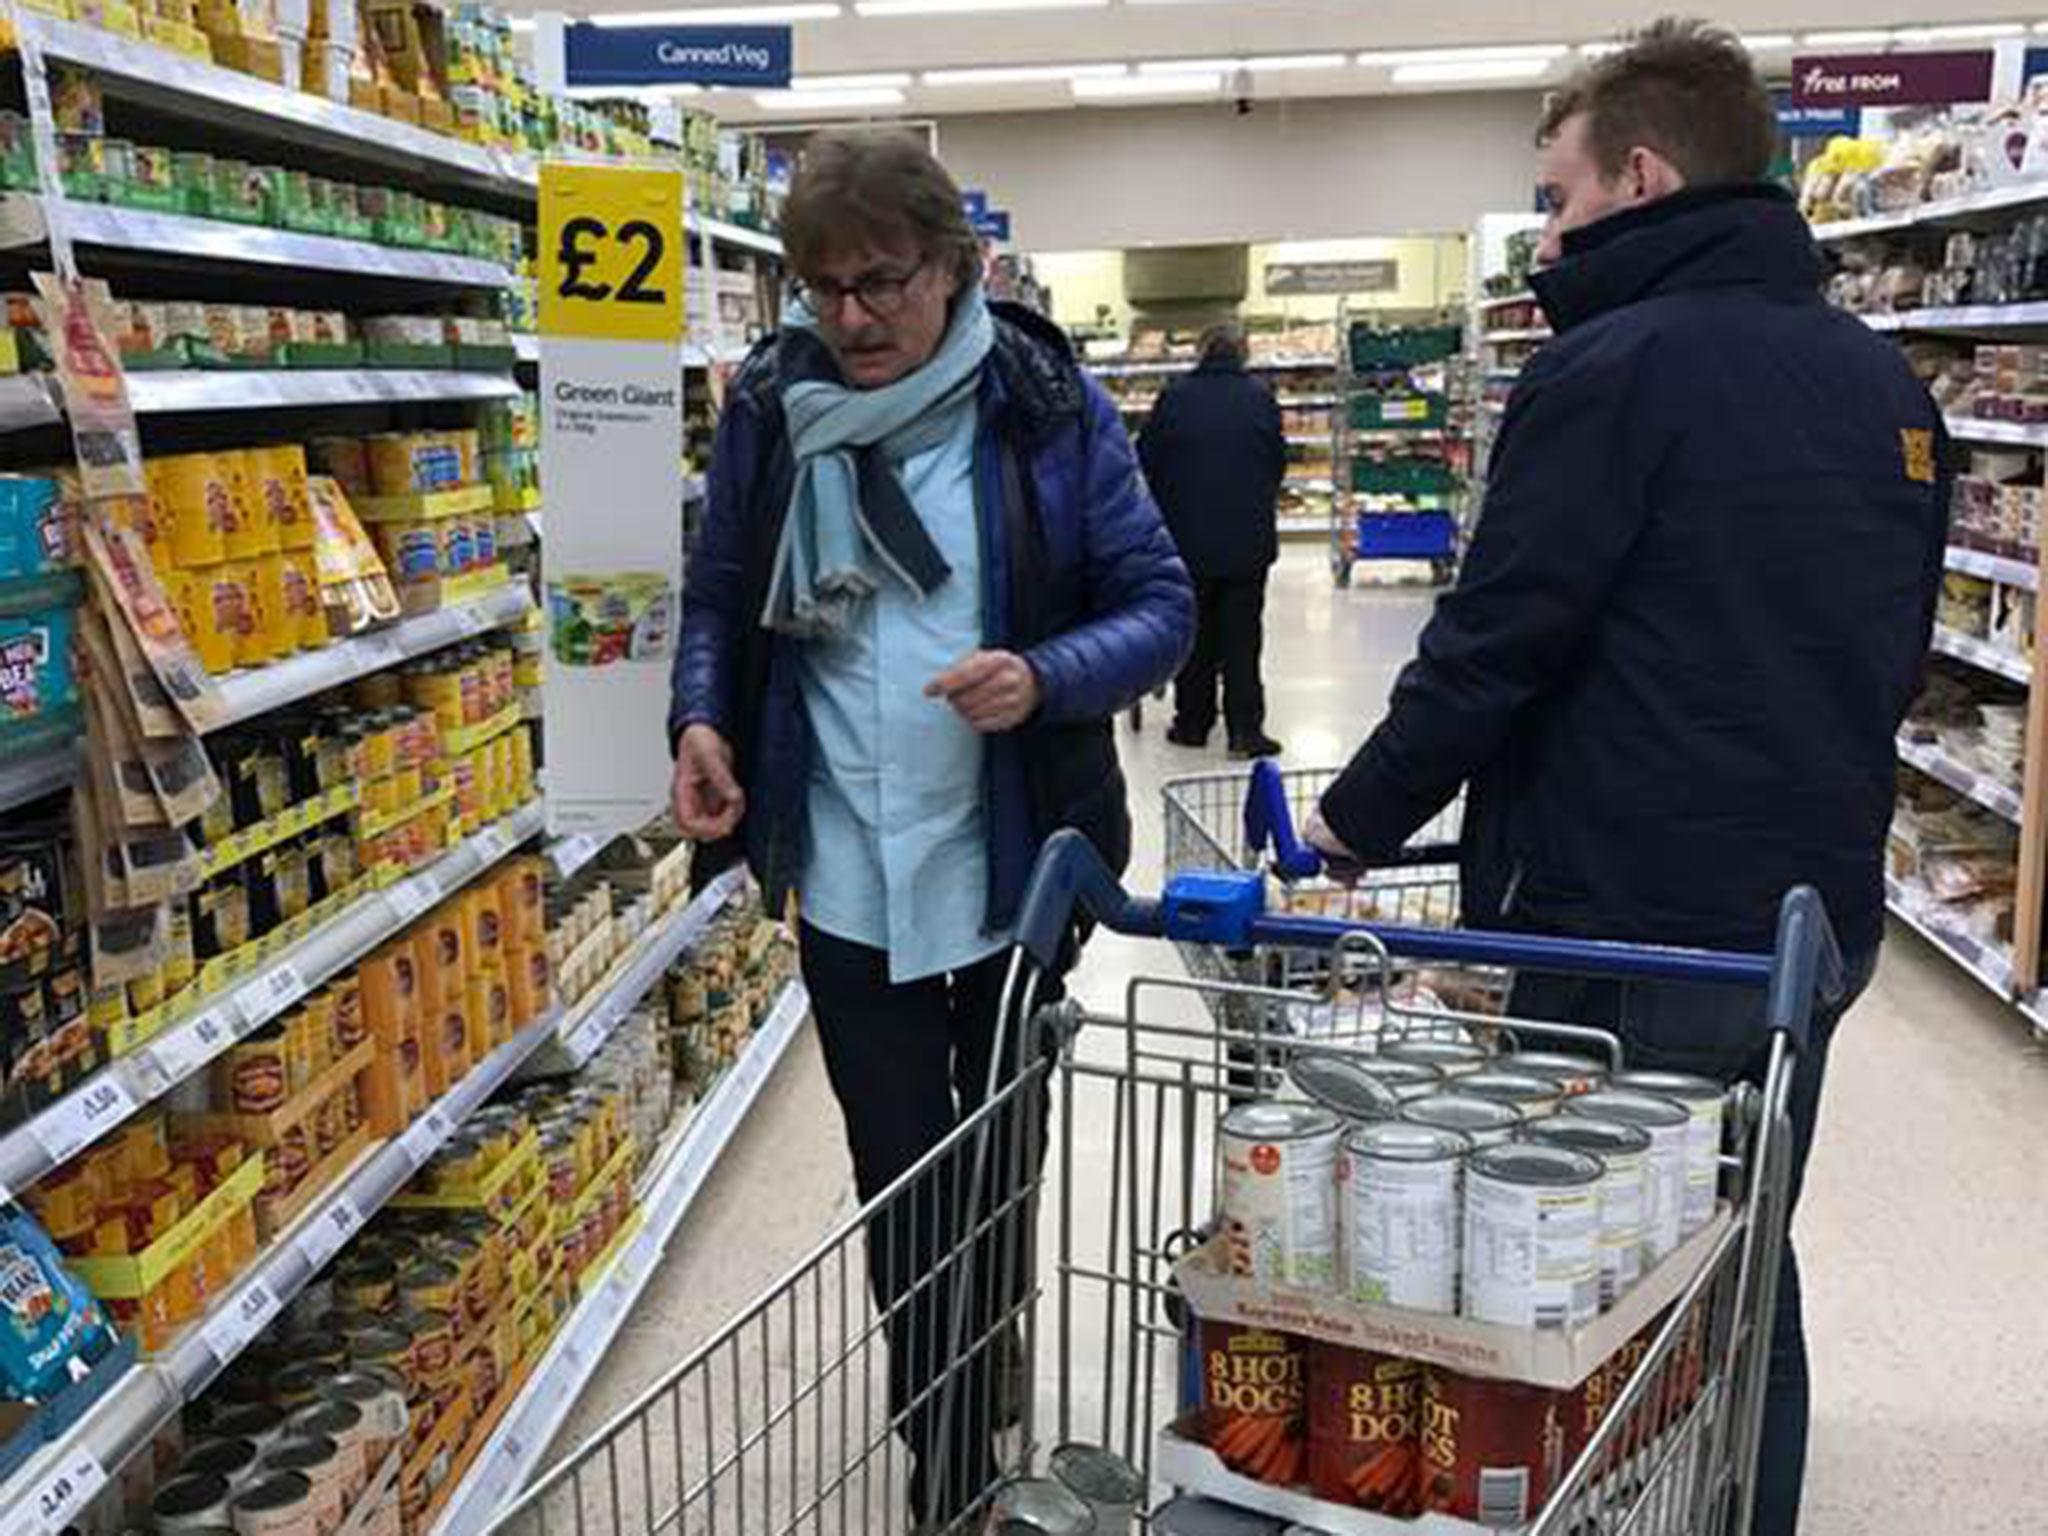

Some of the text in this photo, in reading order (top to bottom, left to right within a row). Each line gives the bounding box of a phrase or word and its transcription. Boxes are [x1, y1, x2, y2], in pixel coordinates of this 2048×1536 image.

[657, 41, 769, 69] Canned Veg
[1851, 74, 1898, 91] FROM
[558, 217, 666, 304] £2
[555, 381, 675, 408] Green Giant
